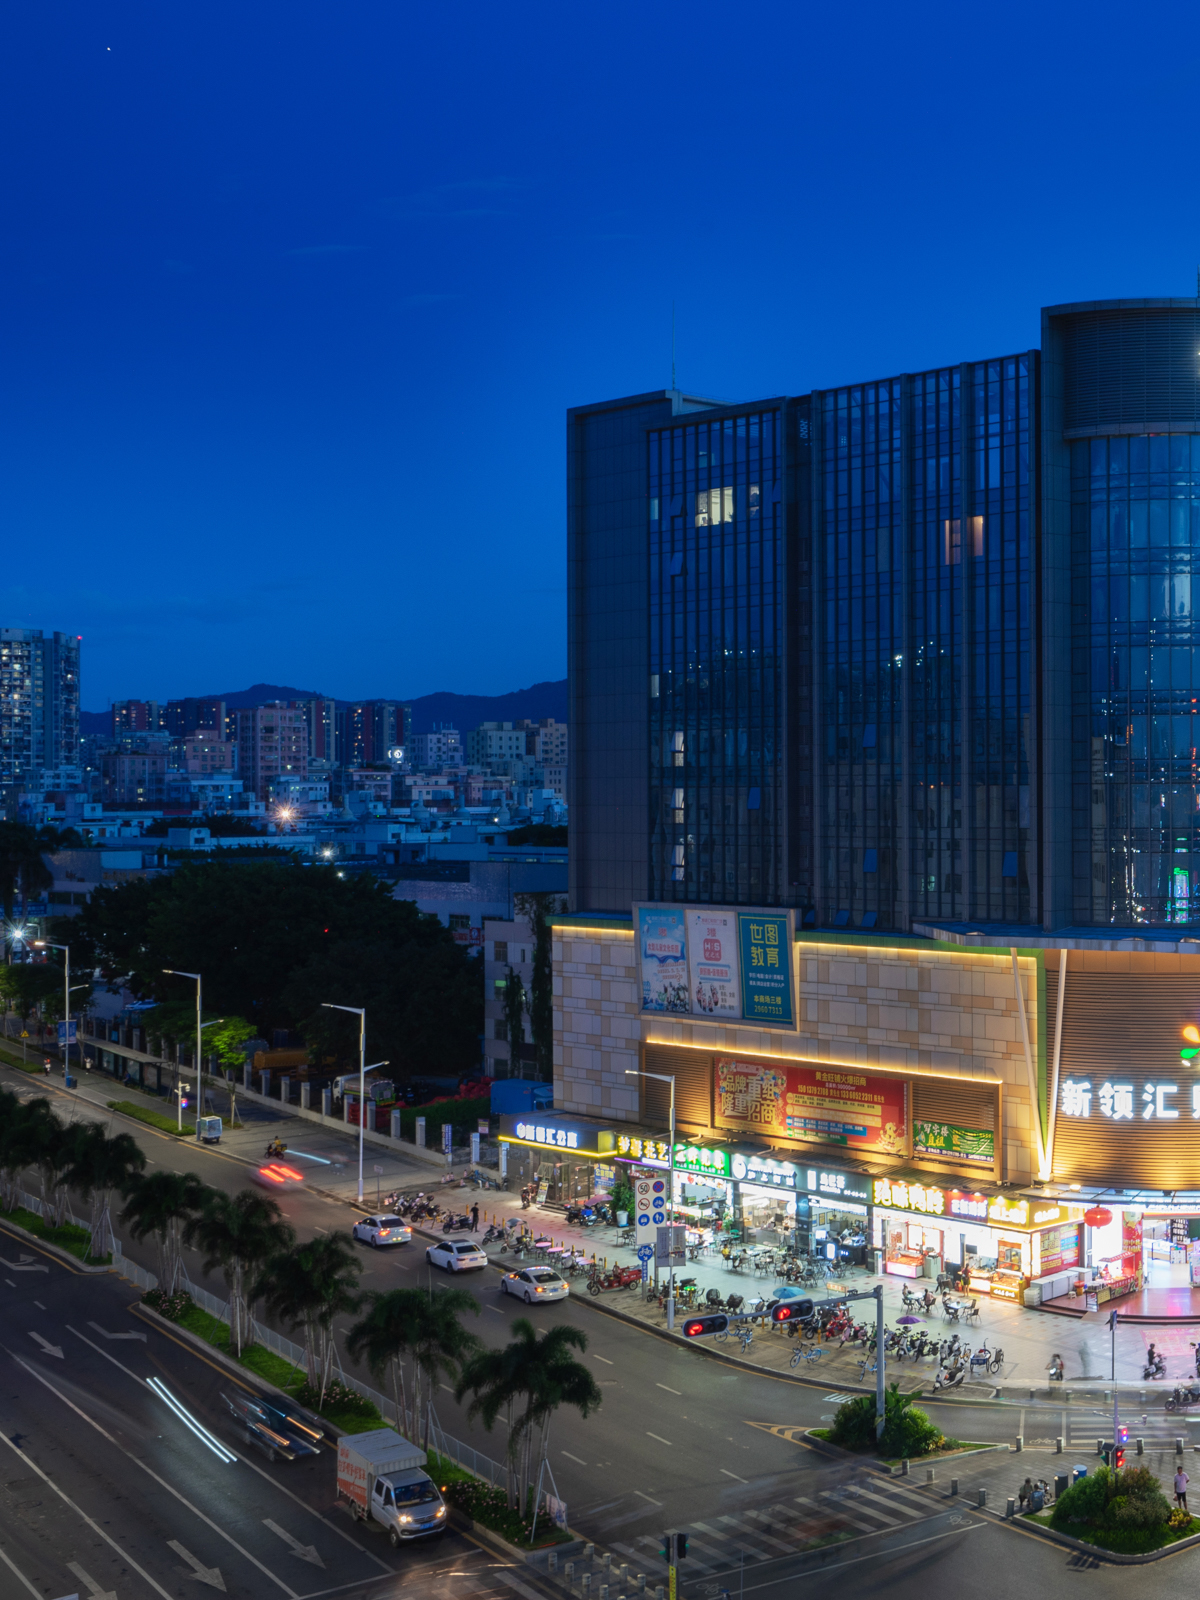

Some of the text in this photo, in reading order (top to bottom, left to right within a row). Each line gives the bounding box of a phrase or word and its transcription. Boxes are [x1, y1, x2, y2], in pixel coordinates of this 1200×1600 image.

[749, 923, 779, 945] 世图
[750, 945, 779, 968] 教育
[724, 1074, 776, 1102] 品牌重组
[815, 1071, 867, 1087] 黄金旺铺火爆招商
[639, 1184, 649, 1194] 50
[874, 1180, 944, 1215] 绝味鸭脖
